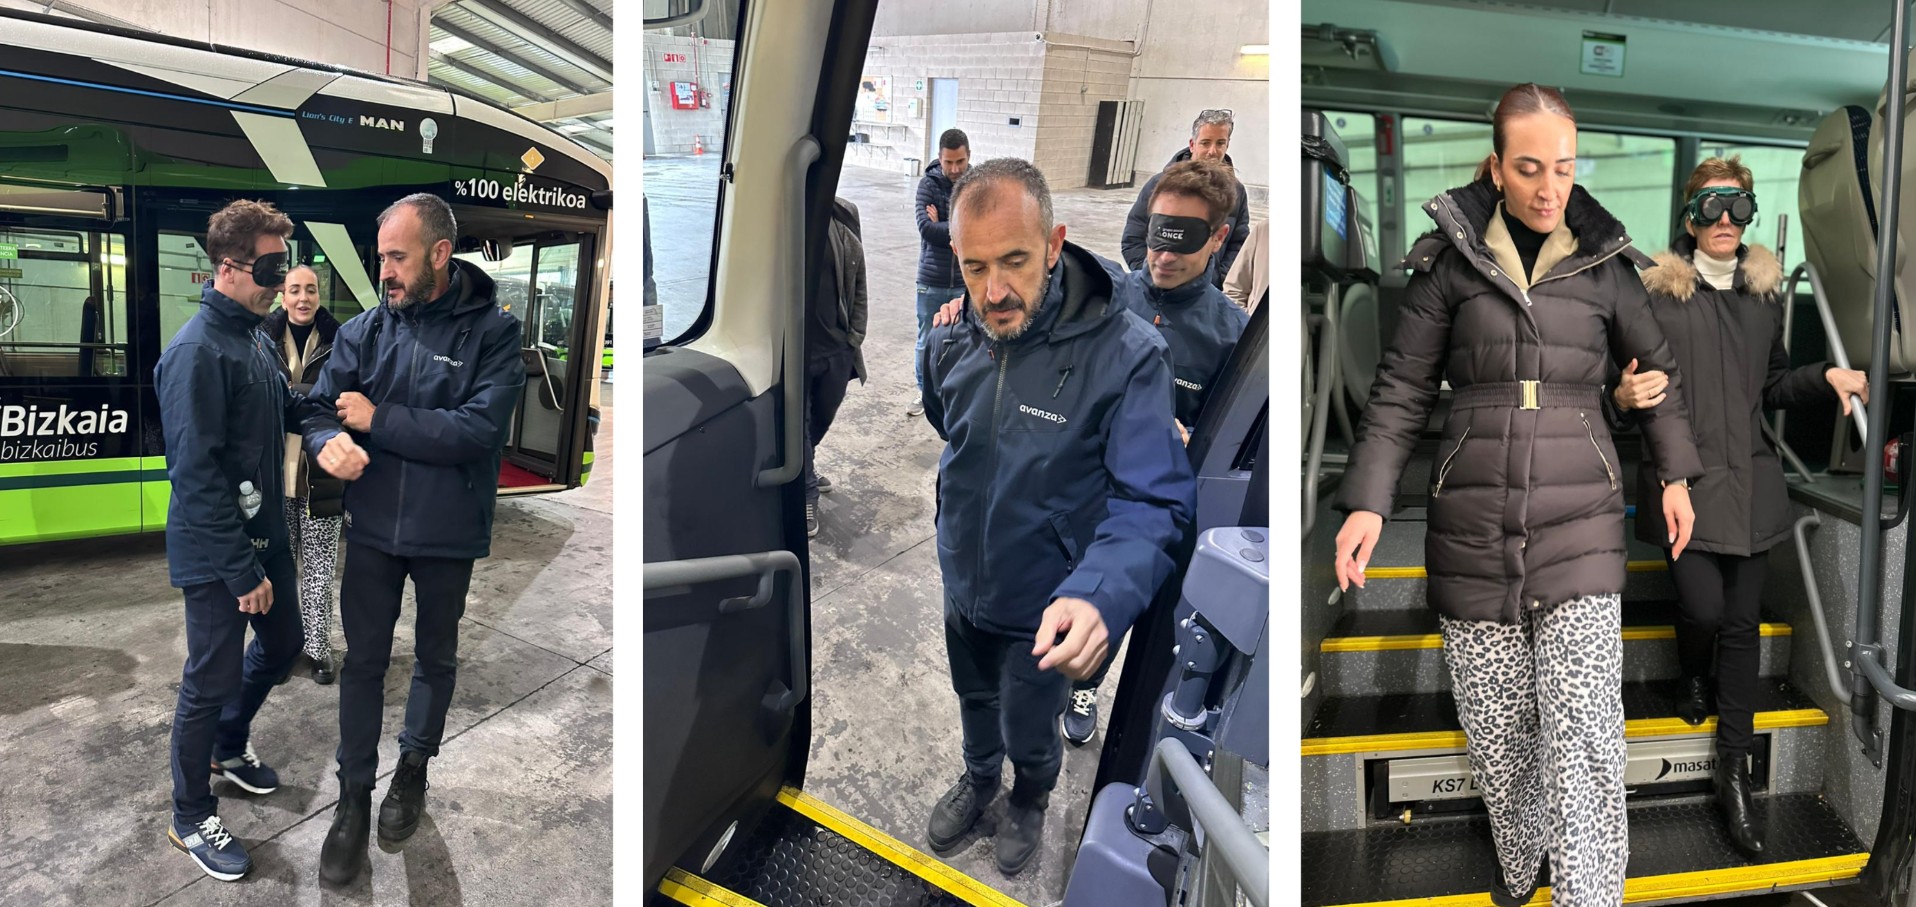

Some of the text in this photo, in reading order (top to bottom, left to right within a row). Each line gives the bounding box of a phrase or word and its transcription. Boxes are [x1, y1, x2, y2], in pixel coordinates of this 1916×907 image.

[302, 111, 326, 121] Lion's
[329, 114, 345, 124] City
[360, 115, 404, 131] MAN
[455, 177, 587, 209] %100 elektrikoa
[1162, 231, 1184, 240] ONCE
[1, 403, 128, 437] Bizkaia
[1019, 404, 1058, 422] avanza
[1, 438, 98, 460] bizkaibus
[1674, 758, 1717, 773] masat
[1432, 777, 1478, 793] KS7 L
